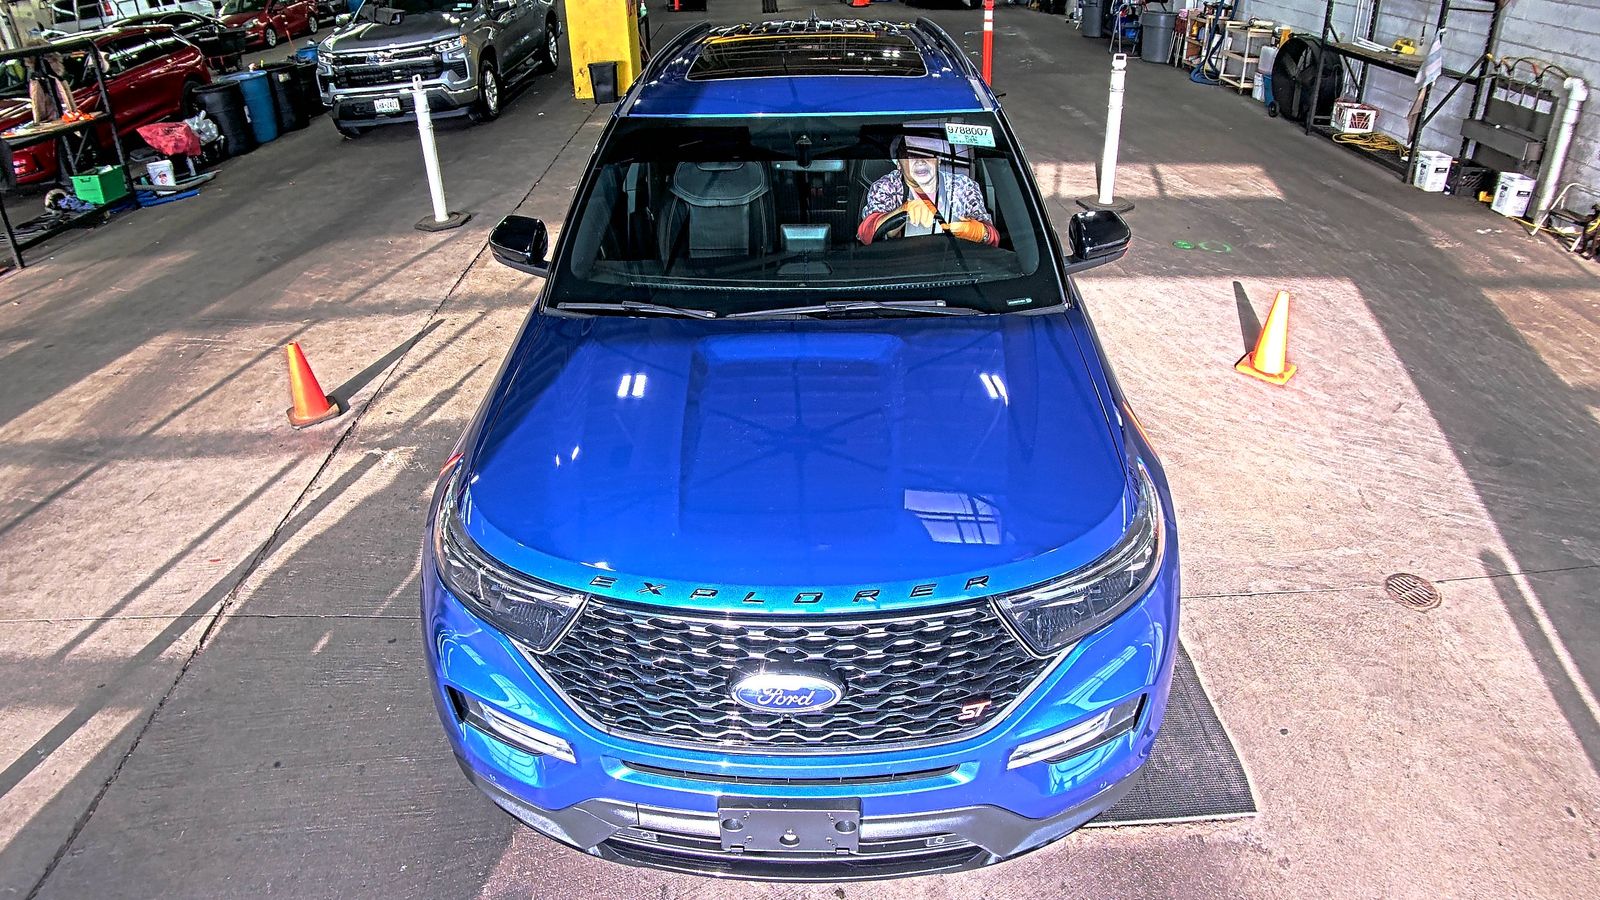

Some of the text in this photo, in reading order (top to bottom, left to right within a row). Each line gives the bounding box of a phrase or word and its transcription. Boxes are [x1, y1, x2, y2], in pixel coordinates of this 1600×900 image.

[947, 125, 988, 136] 9788007
[589, 574, 992, 604] EXPLORER
[757, 687, 815, 706] Ford
[958, 700, 992, 720] ST
